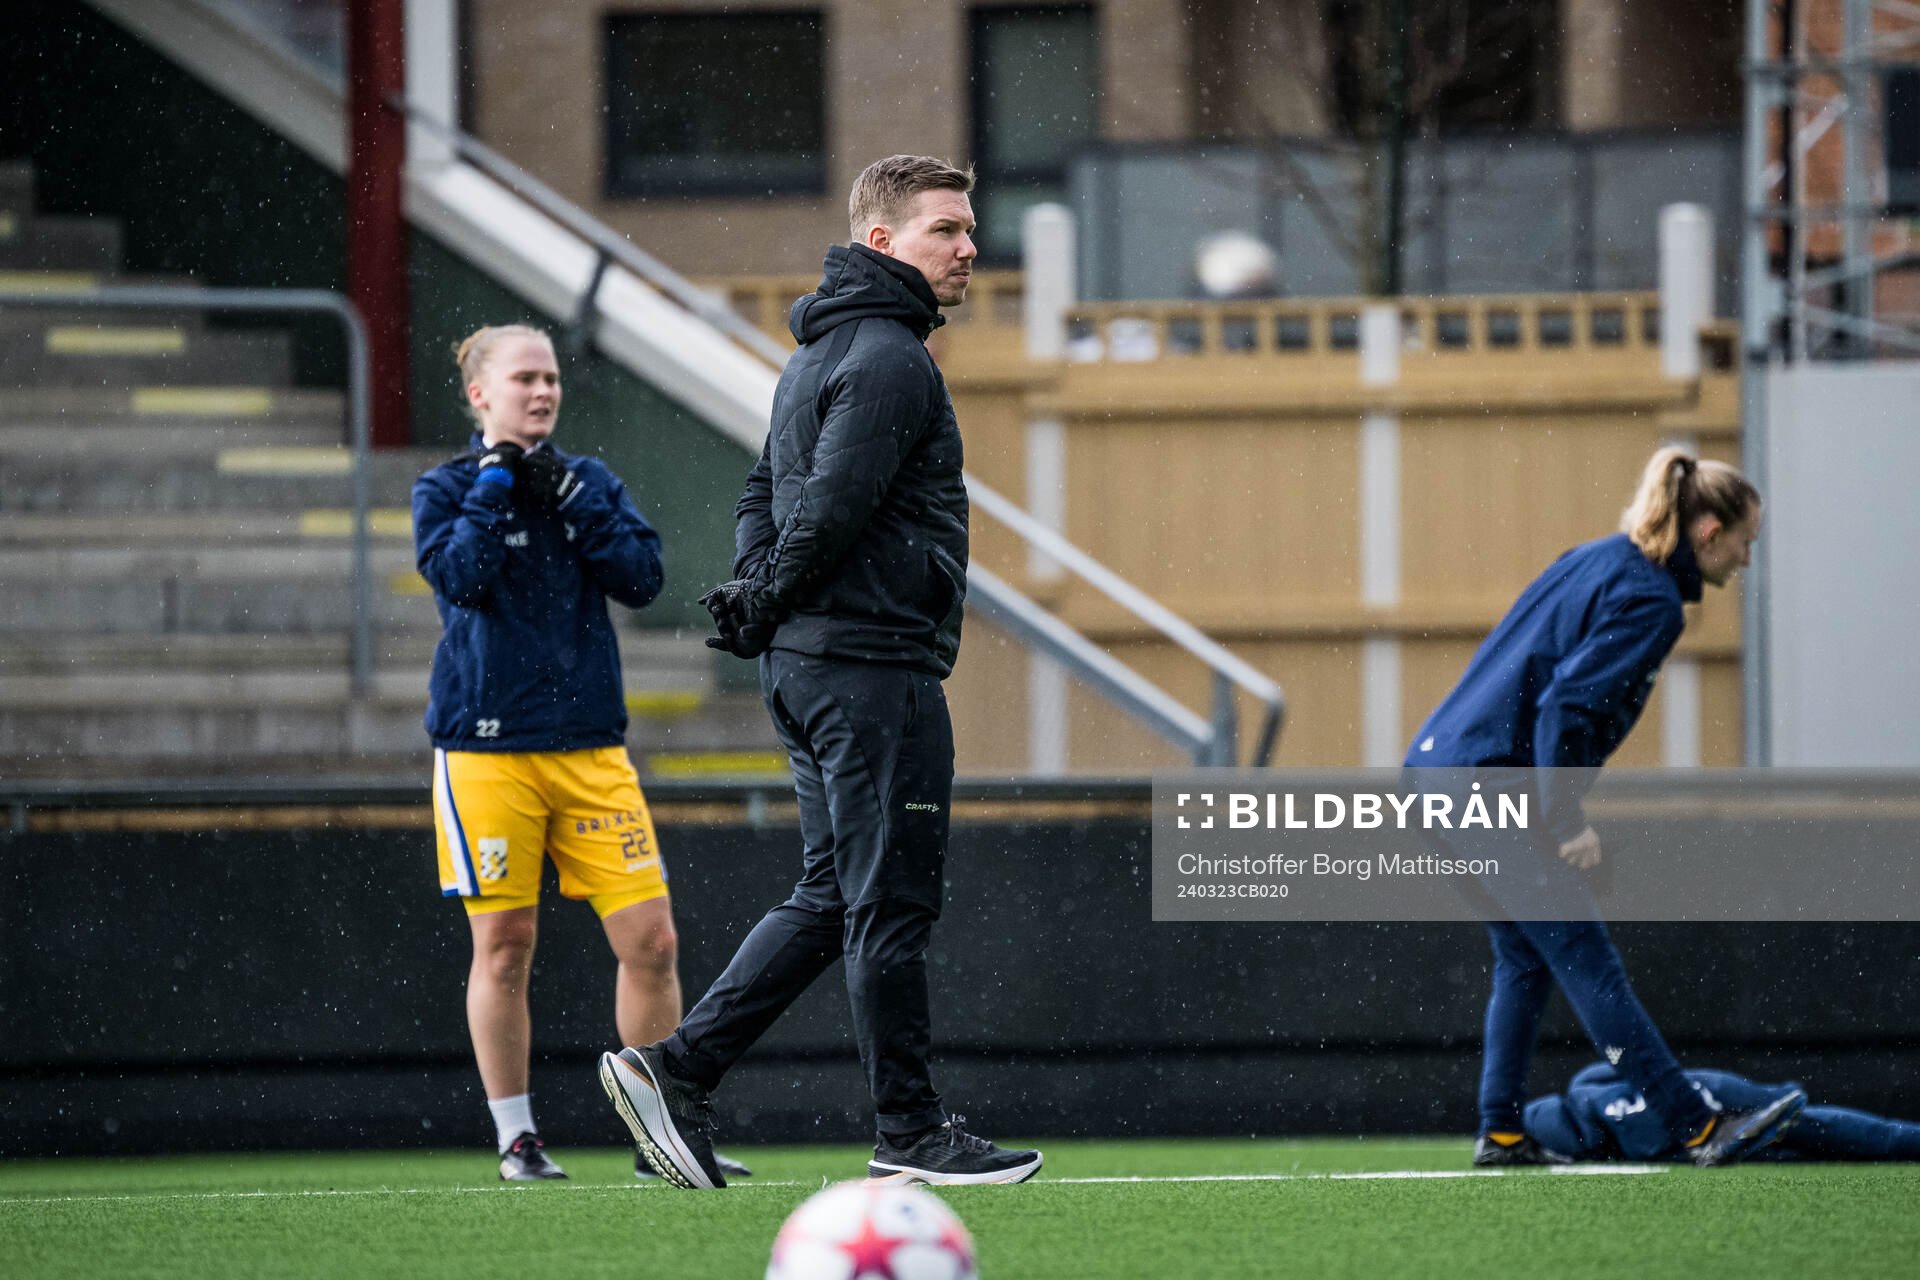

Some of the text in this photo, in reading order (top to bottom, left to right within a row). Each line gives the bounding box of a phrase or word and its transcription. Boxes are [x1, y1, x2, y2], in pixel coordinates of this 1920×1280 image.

[475, 718, 500, 738] 22
[905, 803, 932, 811] CRAFT
[619, 829, 650, 859] 22
